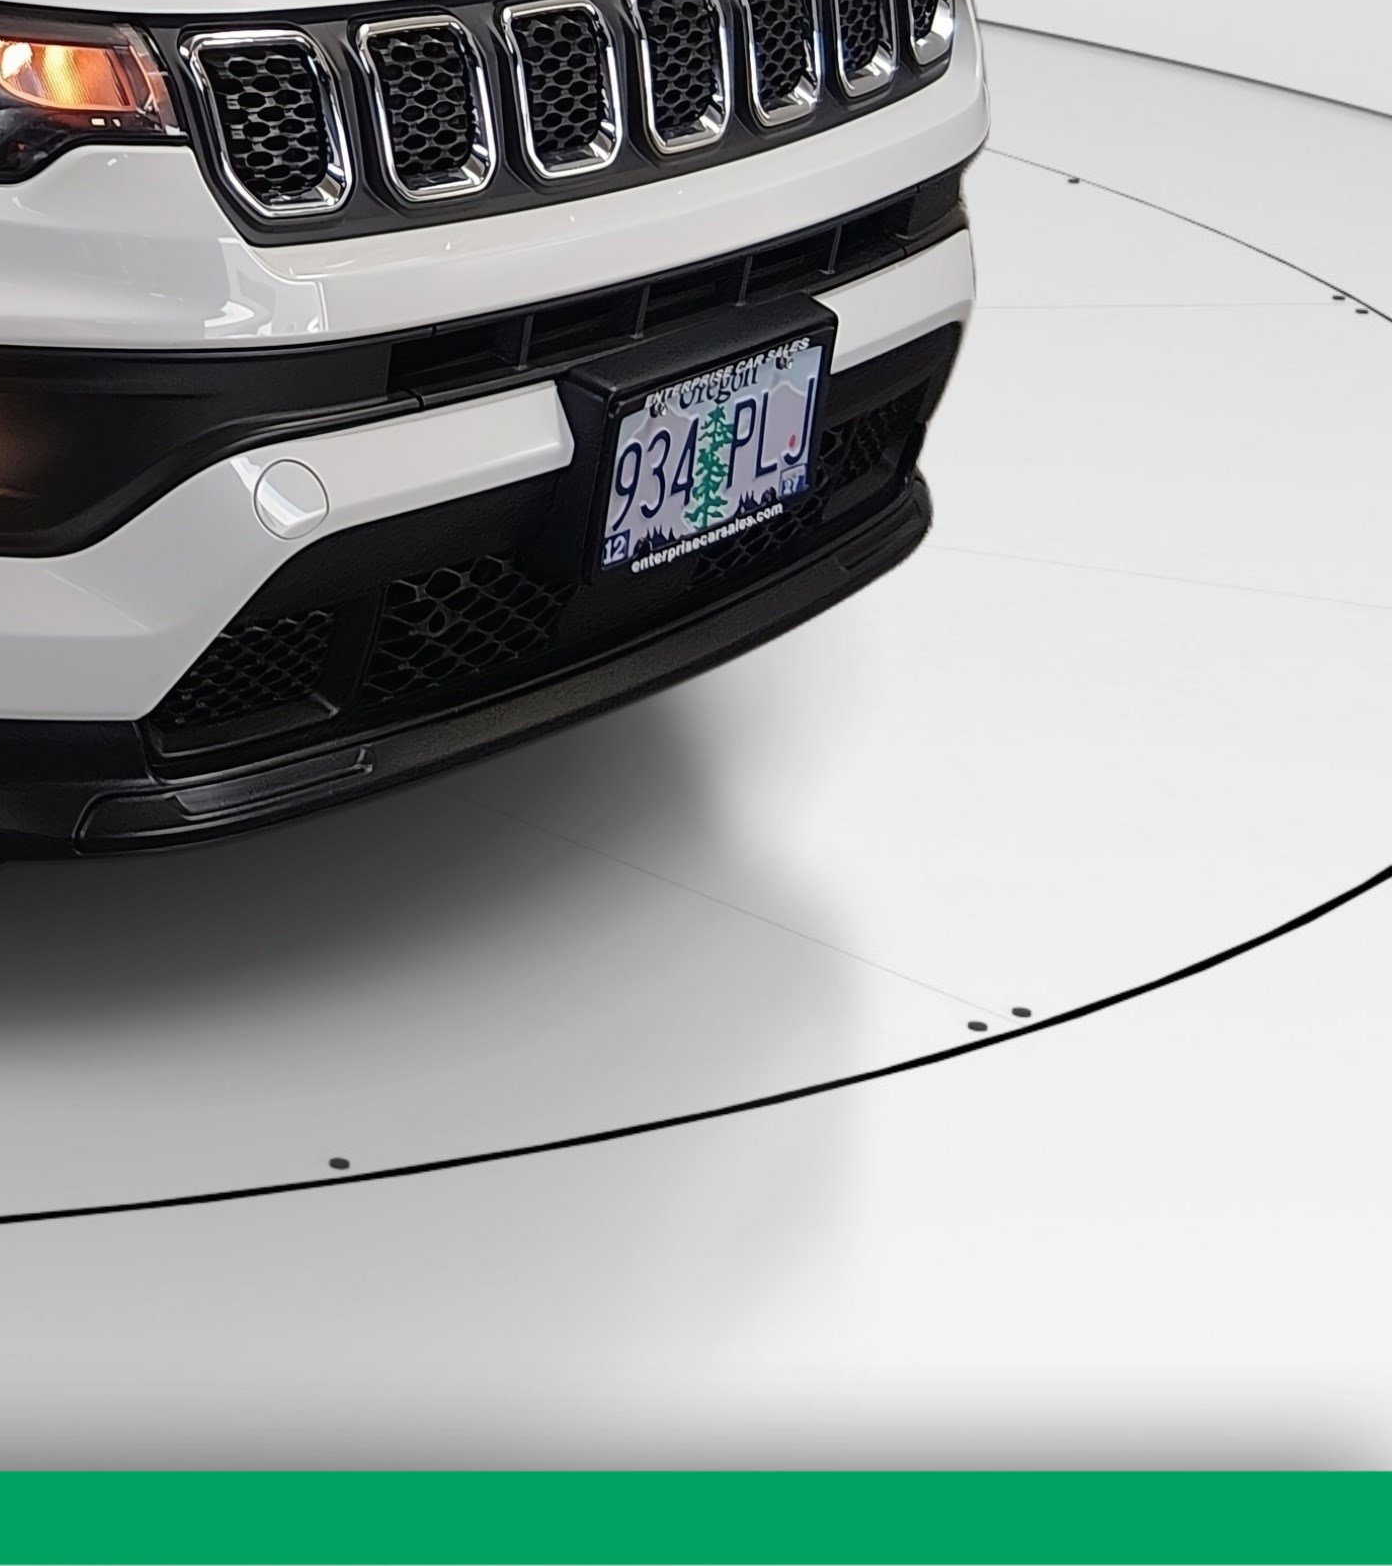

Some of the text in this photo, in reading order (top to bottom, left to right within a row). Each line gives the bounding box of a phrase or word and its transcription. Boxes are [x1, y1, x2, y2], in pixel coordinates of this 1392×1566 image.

[644, 337, 811, 409] ENTERPRISE CAR SALES
[612, 378, 815, 532] 934 PLJ
[602, 535, 627, 565] 12
[631, 503, 783, 574] enterprisecarsales.com
